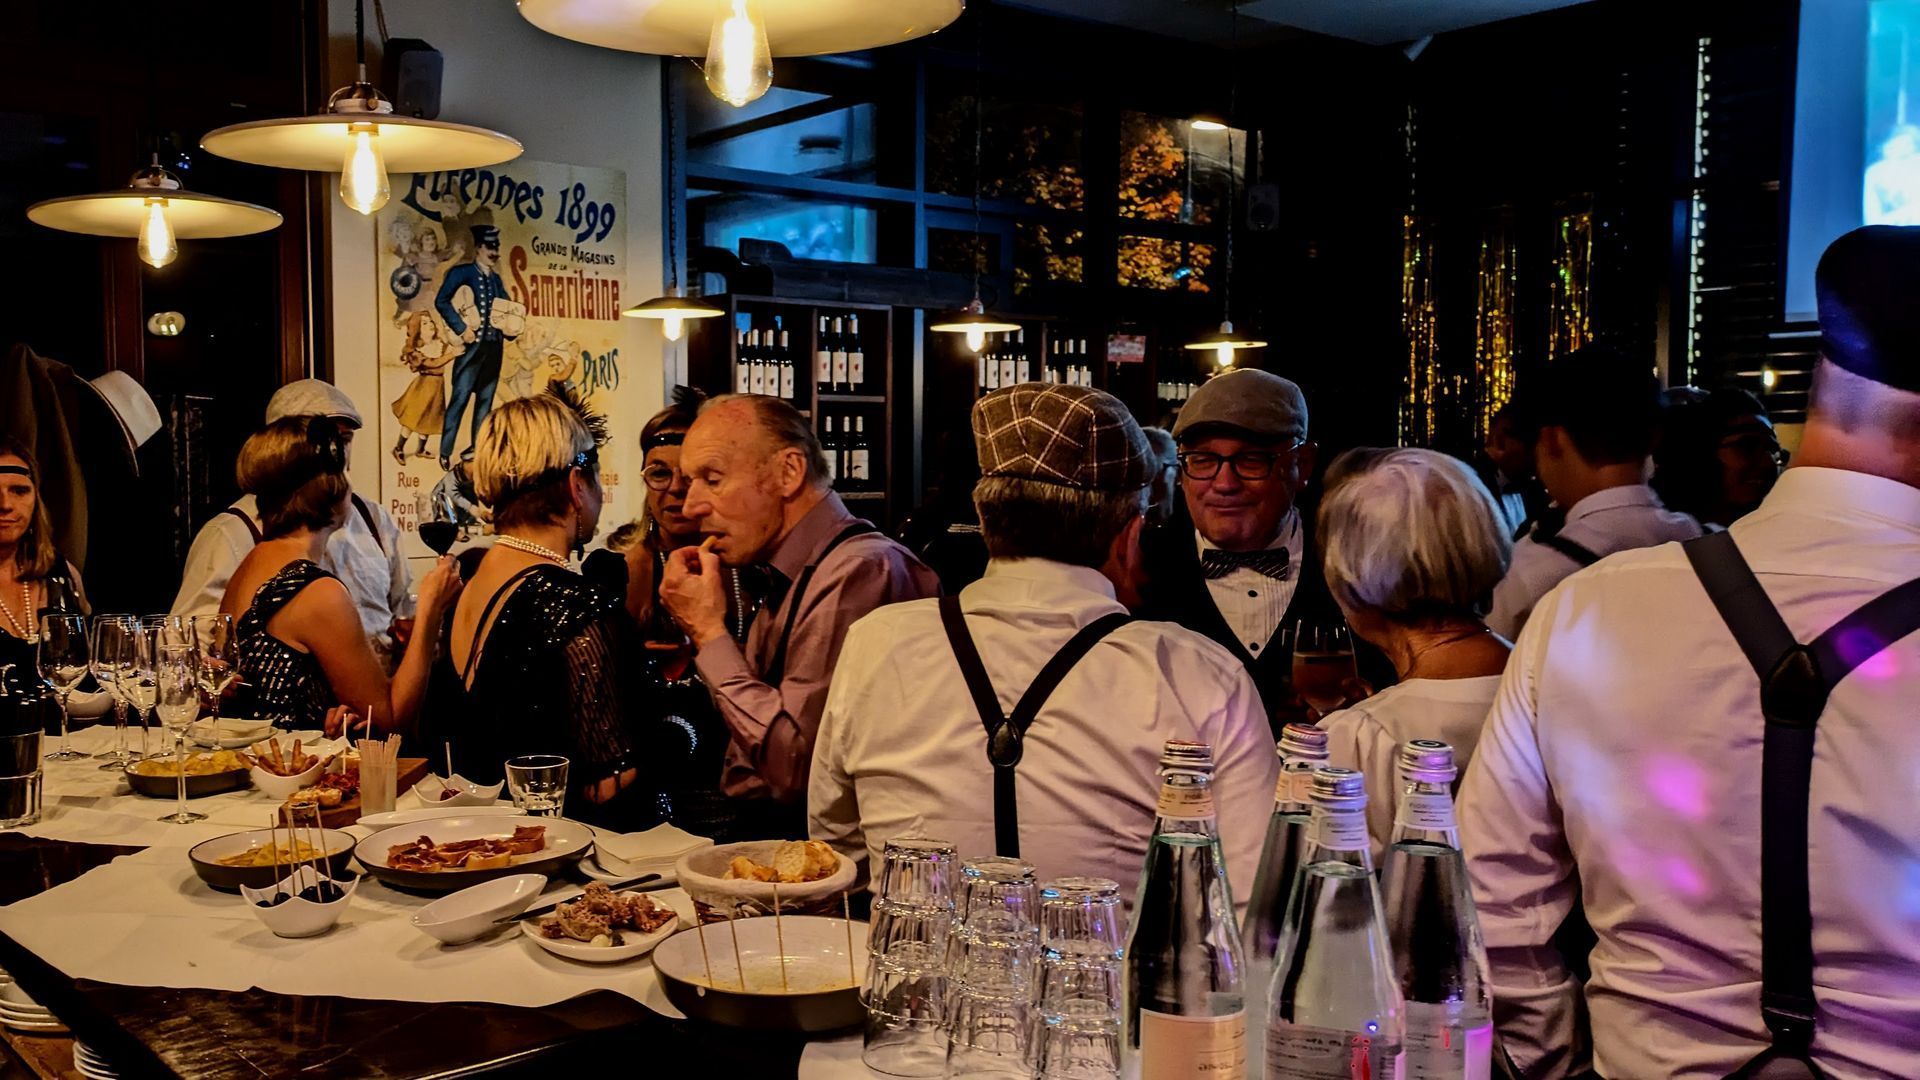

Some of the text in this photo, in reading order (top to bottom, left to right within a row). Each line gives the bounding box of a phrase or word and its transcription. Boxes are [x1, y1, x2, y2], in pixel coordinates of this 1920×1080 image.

[555, 182, 615, 243] 1899
[509, 245, 620, 321] Samaritaine
[580, 348, 619, 397] PARIS
[397, 471, 420, 488] Rue
